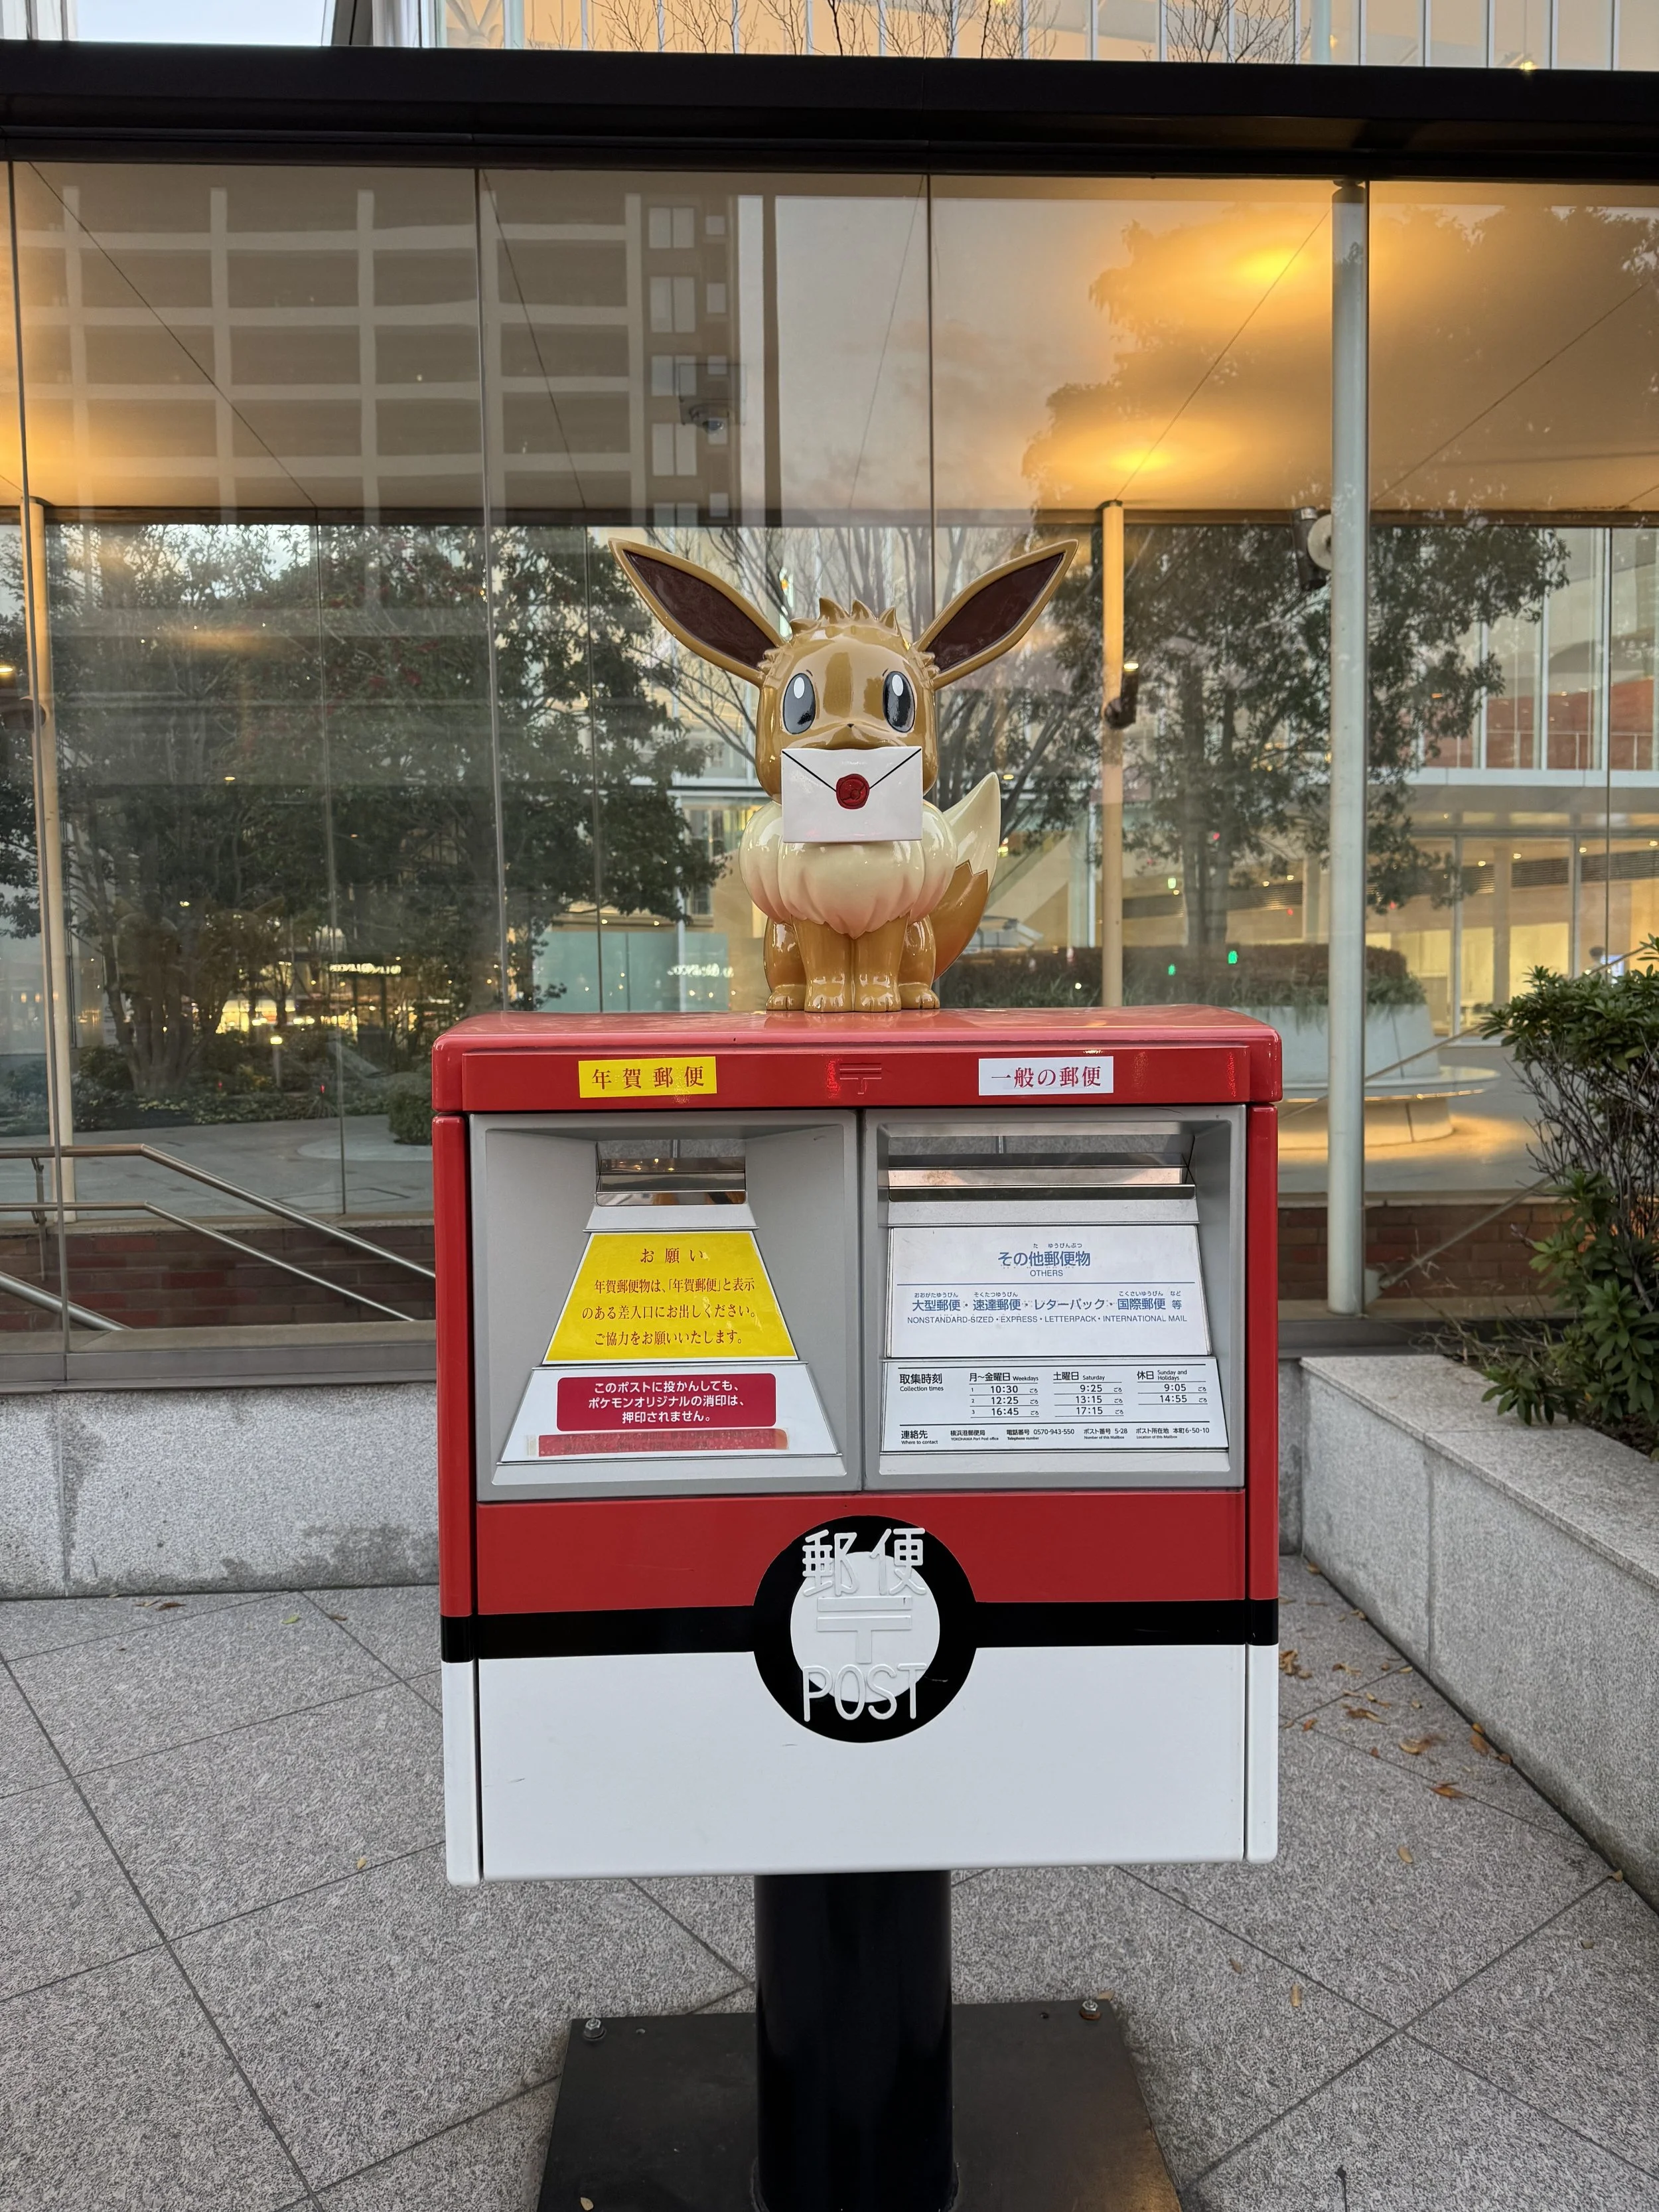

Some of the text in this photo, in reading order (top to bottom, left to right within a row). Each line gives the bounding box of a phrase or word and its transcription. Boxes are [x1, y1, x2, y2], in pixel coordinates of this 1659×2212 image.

[591, 1066, 704, 1090] 年賀郵便
[991, 1066, 1102, 1088] 一般の郵便
[640, 1248, 704, 1264] お願い
[997, 1250, 1090, 1266] その他郵便物
[594, 1277, 755, 1293] 年賀郵便物は、「年賀郵便」と表示
[1172, 1299, 1182, 1310] 等
[582, 1304, 757, 1319] のある差入口にお出しください。
[595, 1330, 743, 1347] ご協力をお願いいたします。
[899, 1373, 942, 1384] 取集時刻
[1053, 1371, 1079, 1381] 土曜日
[1137, 1370, 1154, 1380] 休日
[595, 1380, 739, 1394] このポストに投かんしても、
[991, 1385, 1019, 1394] 10:30
[1080, 1384, 1102, 1392] 9:25
[1164, 1383, 1187, 1392] 9:05
[588, 1394, 745, 1409] ポケモンオリジナルの消印は、
[1160, 1394, 1187, 1403] 14:55
[1076, 1406, 1103, 1415] 17:15
[622, 1411, 711, 1424] 押印されません。
[901, 1430, 928, 1439] 連絡先
[802, 1528, 927, 1597] 郵便
[802, 1663, 927, 1722] POST
